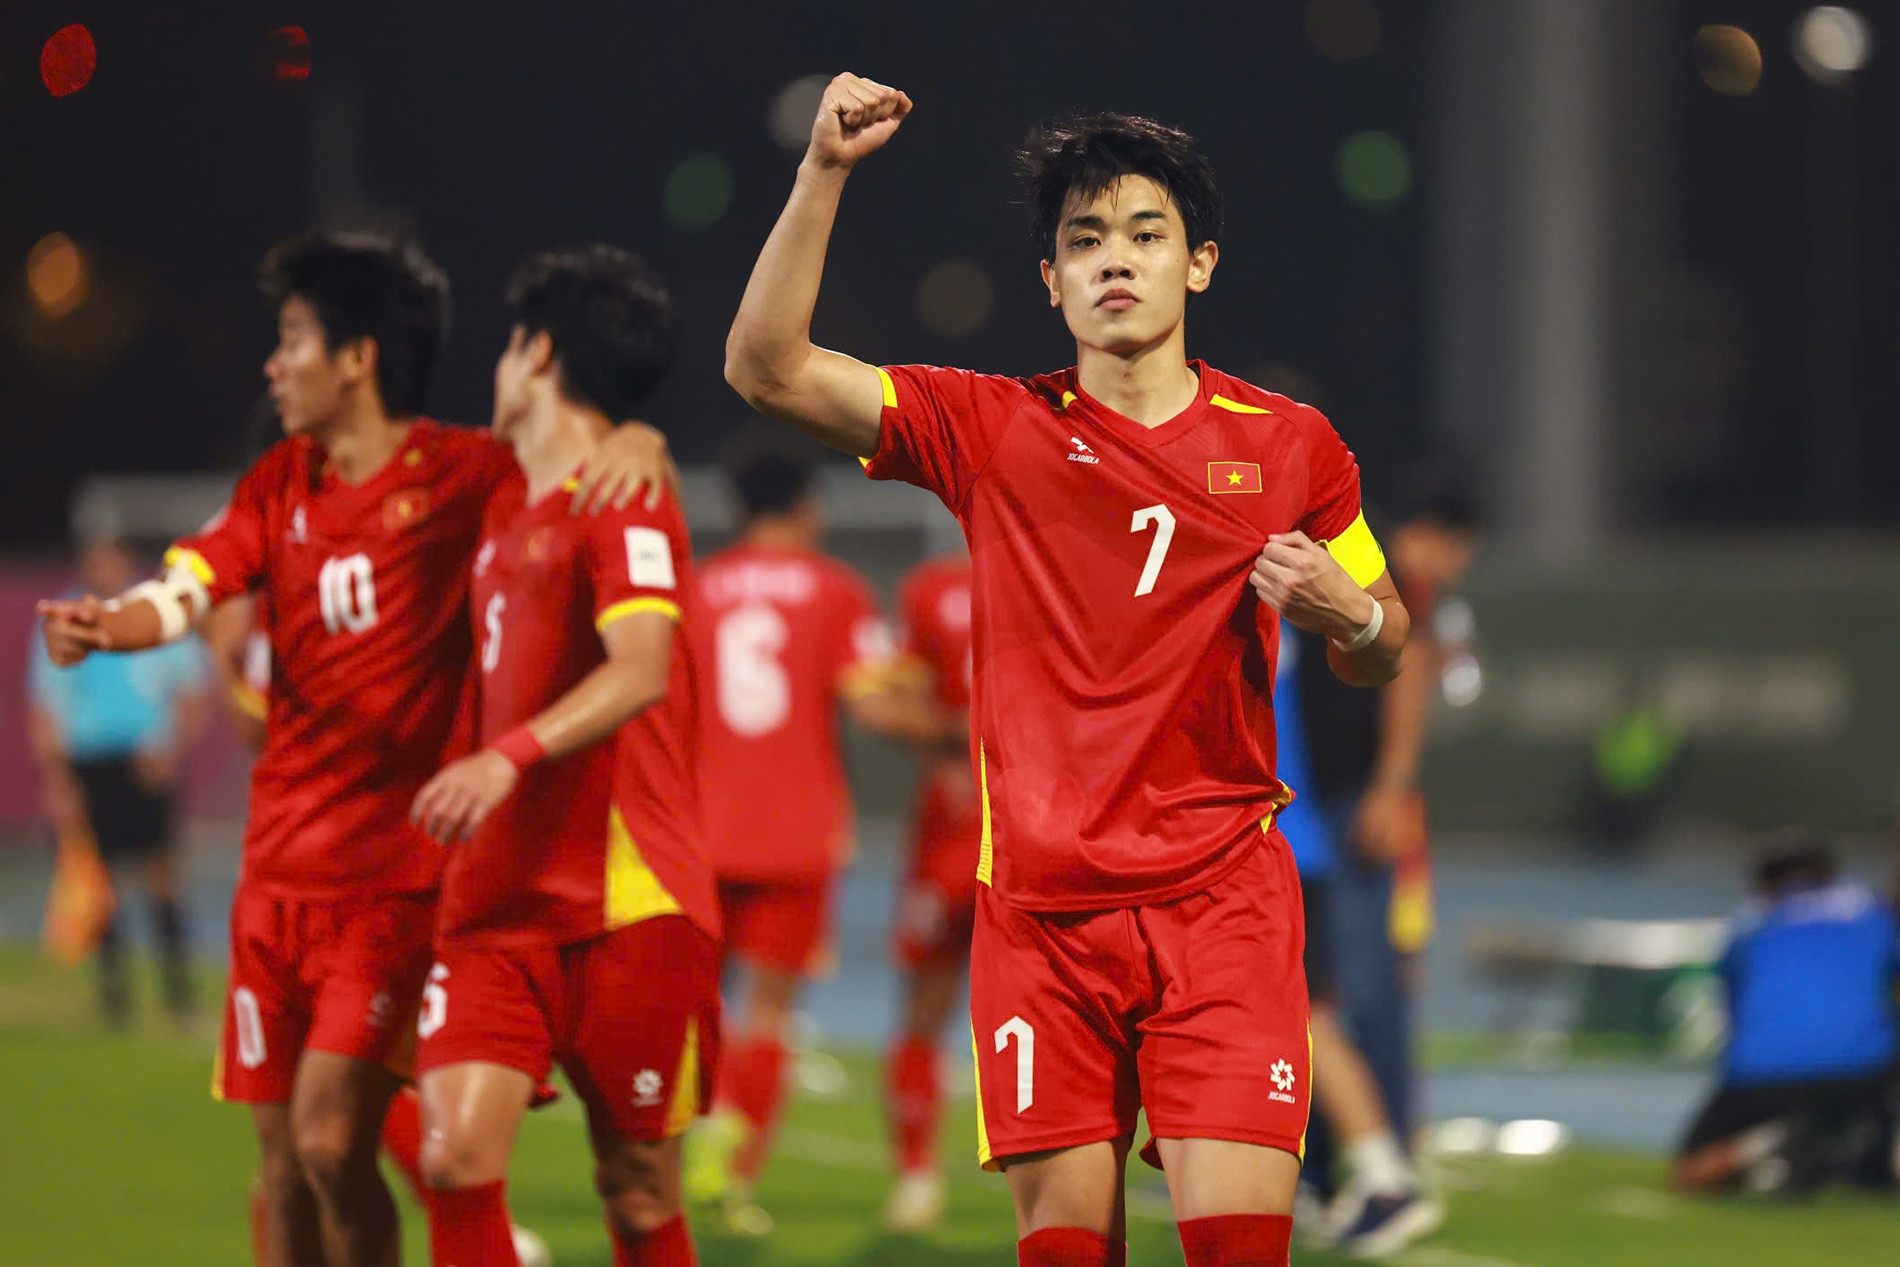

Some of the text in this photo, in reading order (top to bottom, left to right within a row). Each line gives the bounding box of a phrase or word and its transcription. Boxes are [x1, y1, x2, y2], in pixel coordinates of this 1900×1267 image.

[318, 552, 379, 636] 10
[1130, 503, 1177, 598] 7
[714, 604, 792, 739] 6
[994, 1015, 1035, 1115] 7
